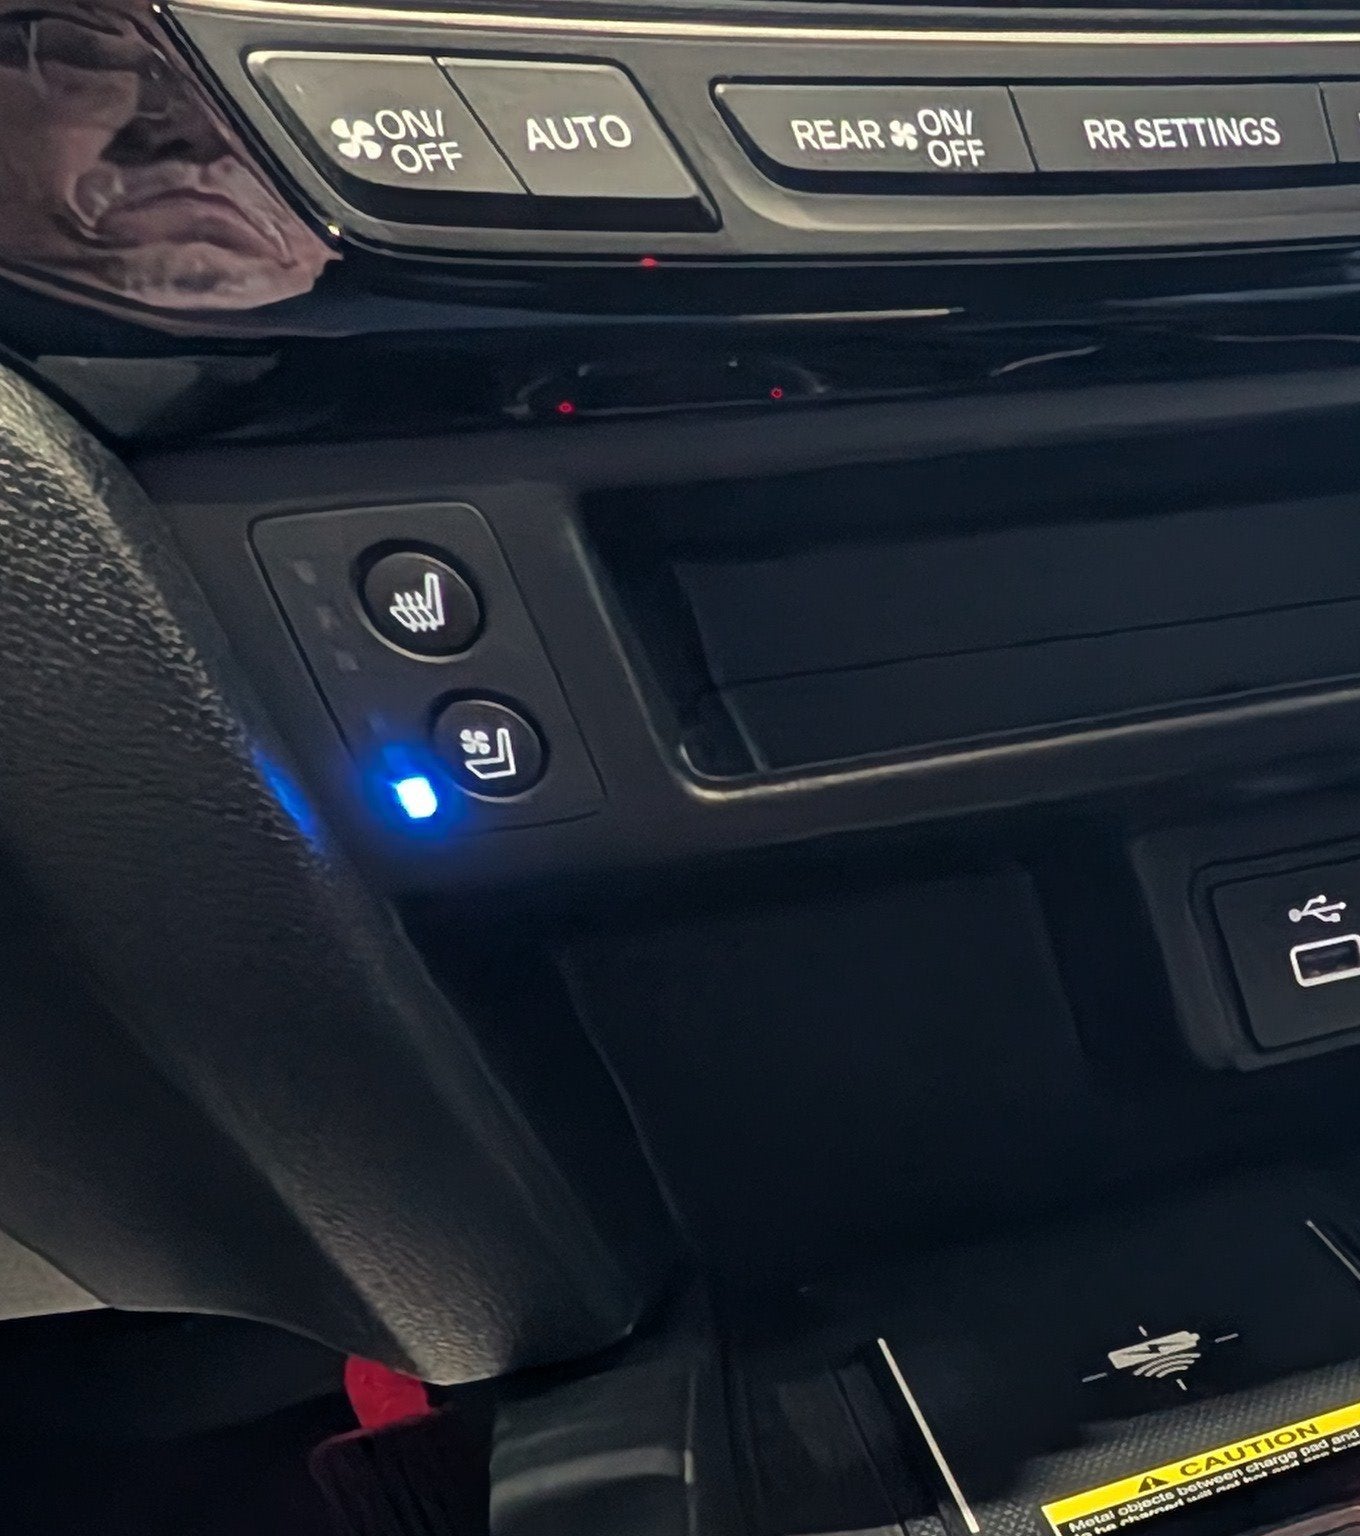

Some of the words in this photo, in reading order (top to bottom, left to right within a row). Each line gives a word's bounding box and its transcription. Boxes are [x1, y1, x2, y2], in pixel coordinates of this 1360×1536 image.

[374, 108, 446, 140] ON/
[525, 113, 633, 153] AUTO
[790, 117, 886, 151] REAR
[916, 107, 974, 137] ON/
[1082, 118, 1132, 150] RR
[1136, 116, 1282, 150] SETTINGS
[390, 140, 463, 175] OFF
[926, 137, 987, 167] OFF
[1179, 1422, 1321, 1478] CAUTION
[1068, 1509, 1116, 1534] Metal
[1117, 1491, 1175, 1516] objects
[1176, 1468, 1244, 1498] between
[1245, 1450, 1298, 1475] charge
[1300, 1439, 1329, 1458] pad
[1331, 1428, 1359, 1445] and
